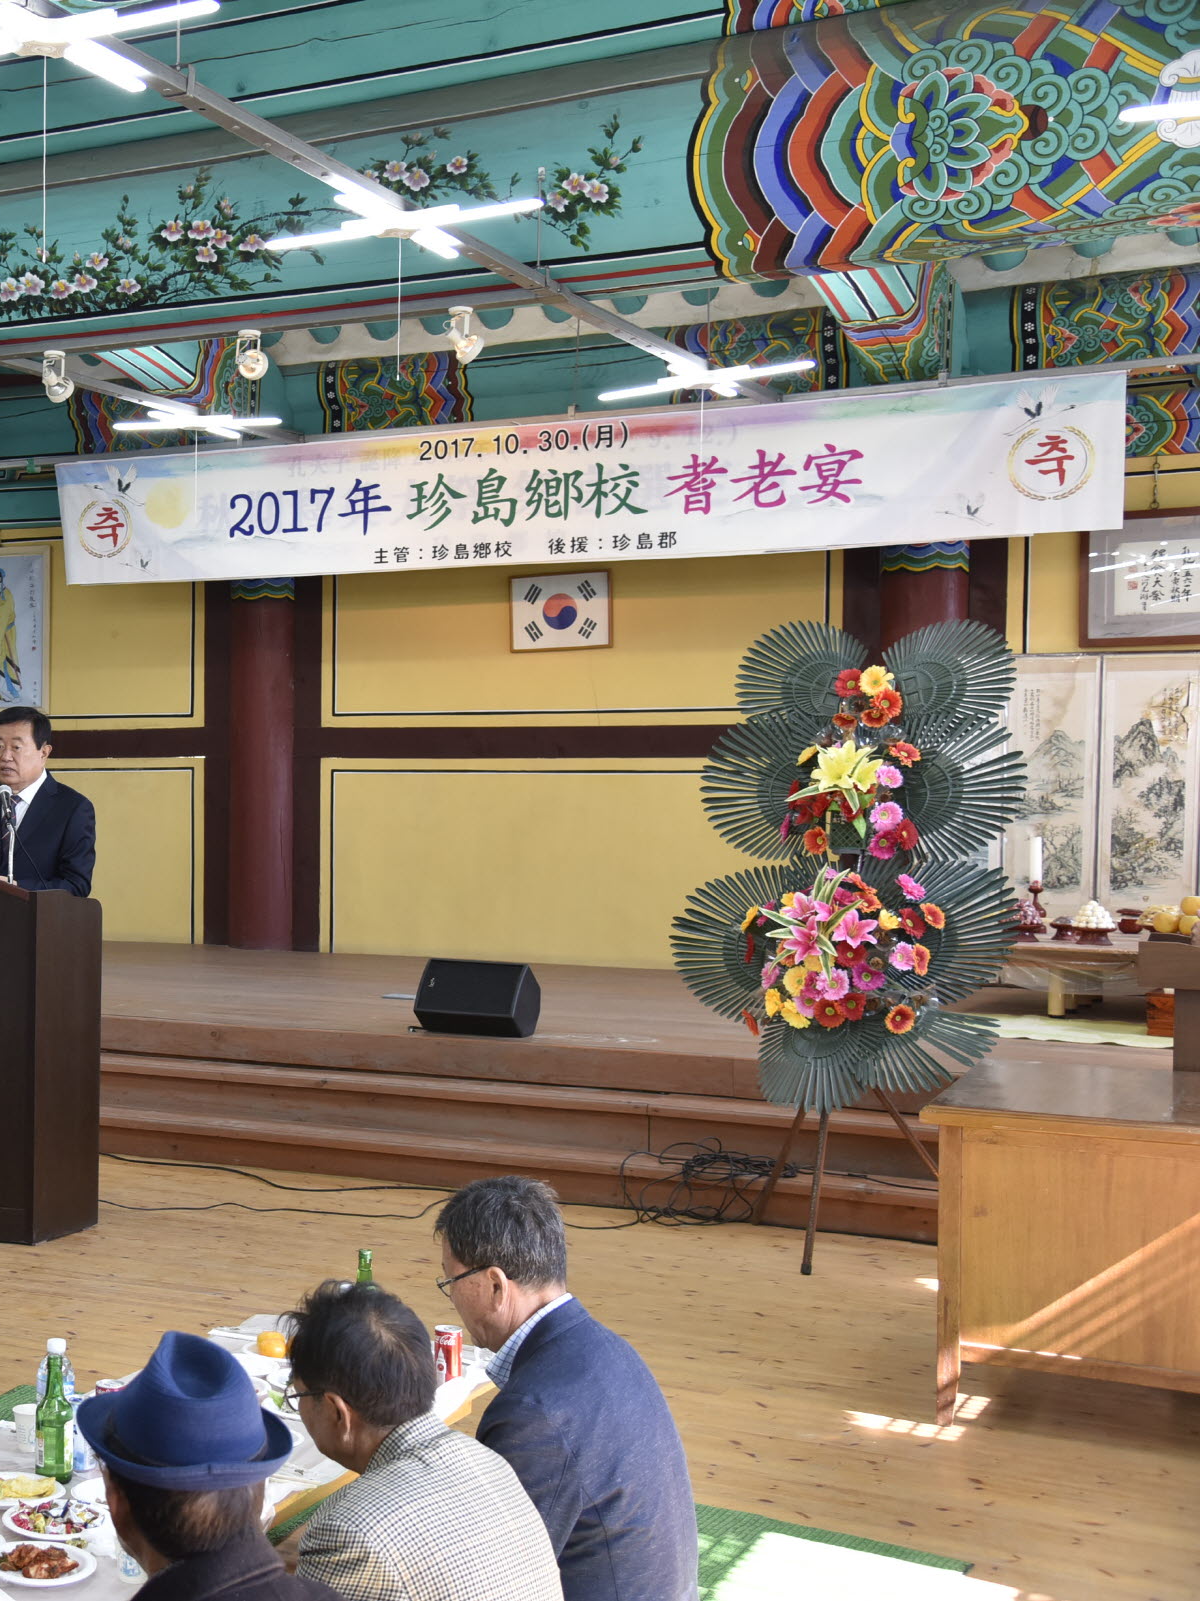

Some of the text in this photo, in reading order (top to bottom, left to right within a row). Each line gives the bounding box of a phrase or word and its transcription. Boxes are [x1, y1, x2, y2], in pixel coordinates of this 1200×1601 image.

[1024, 435, 1075, 487] 축
[228, 476, 393, 539] 2017年
[663, 443, 865, 516] 耆老宴
[86, 507, 125, 548] 축
